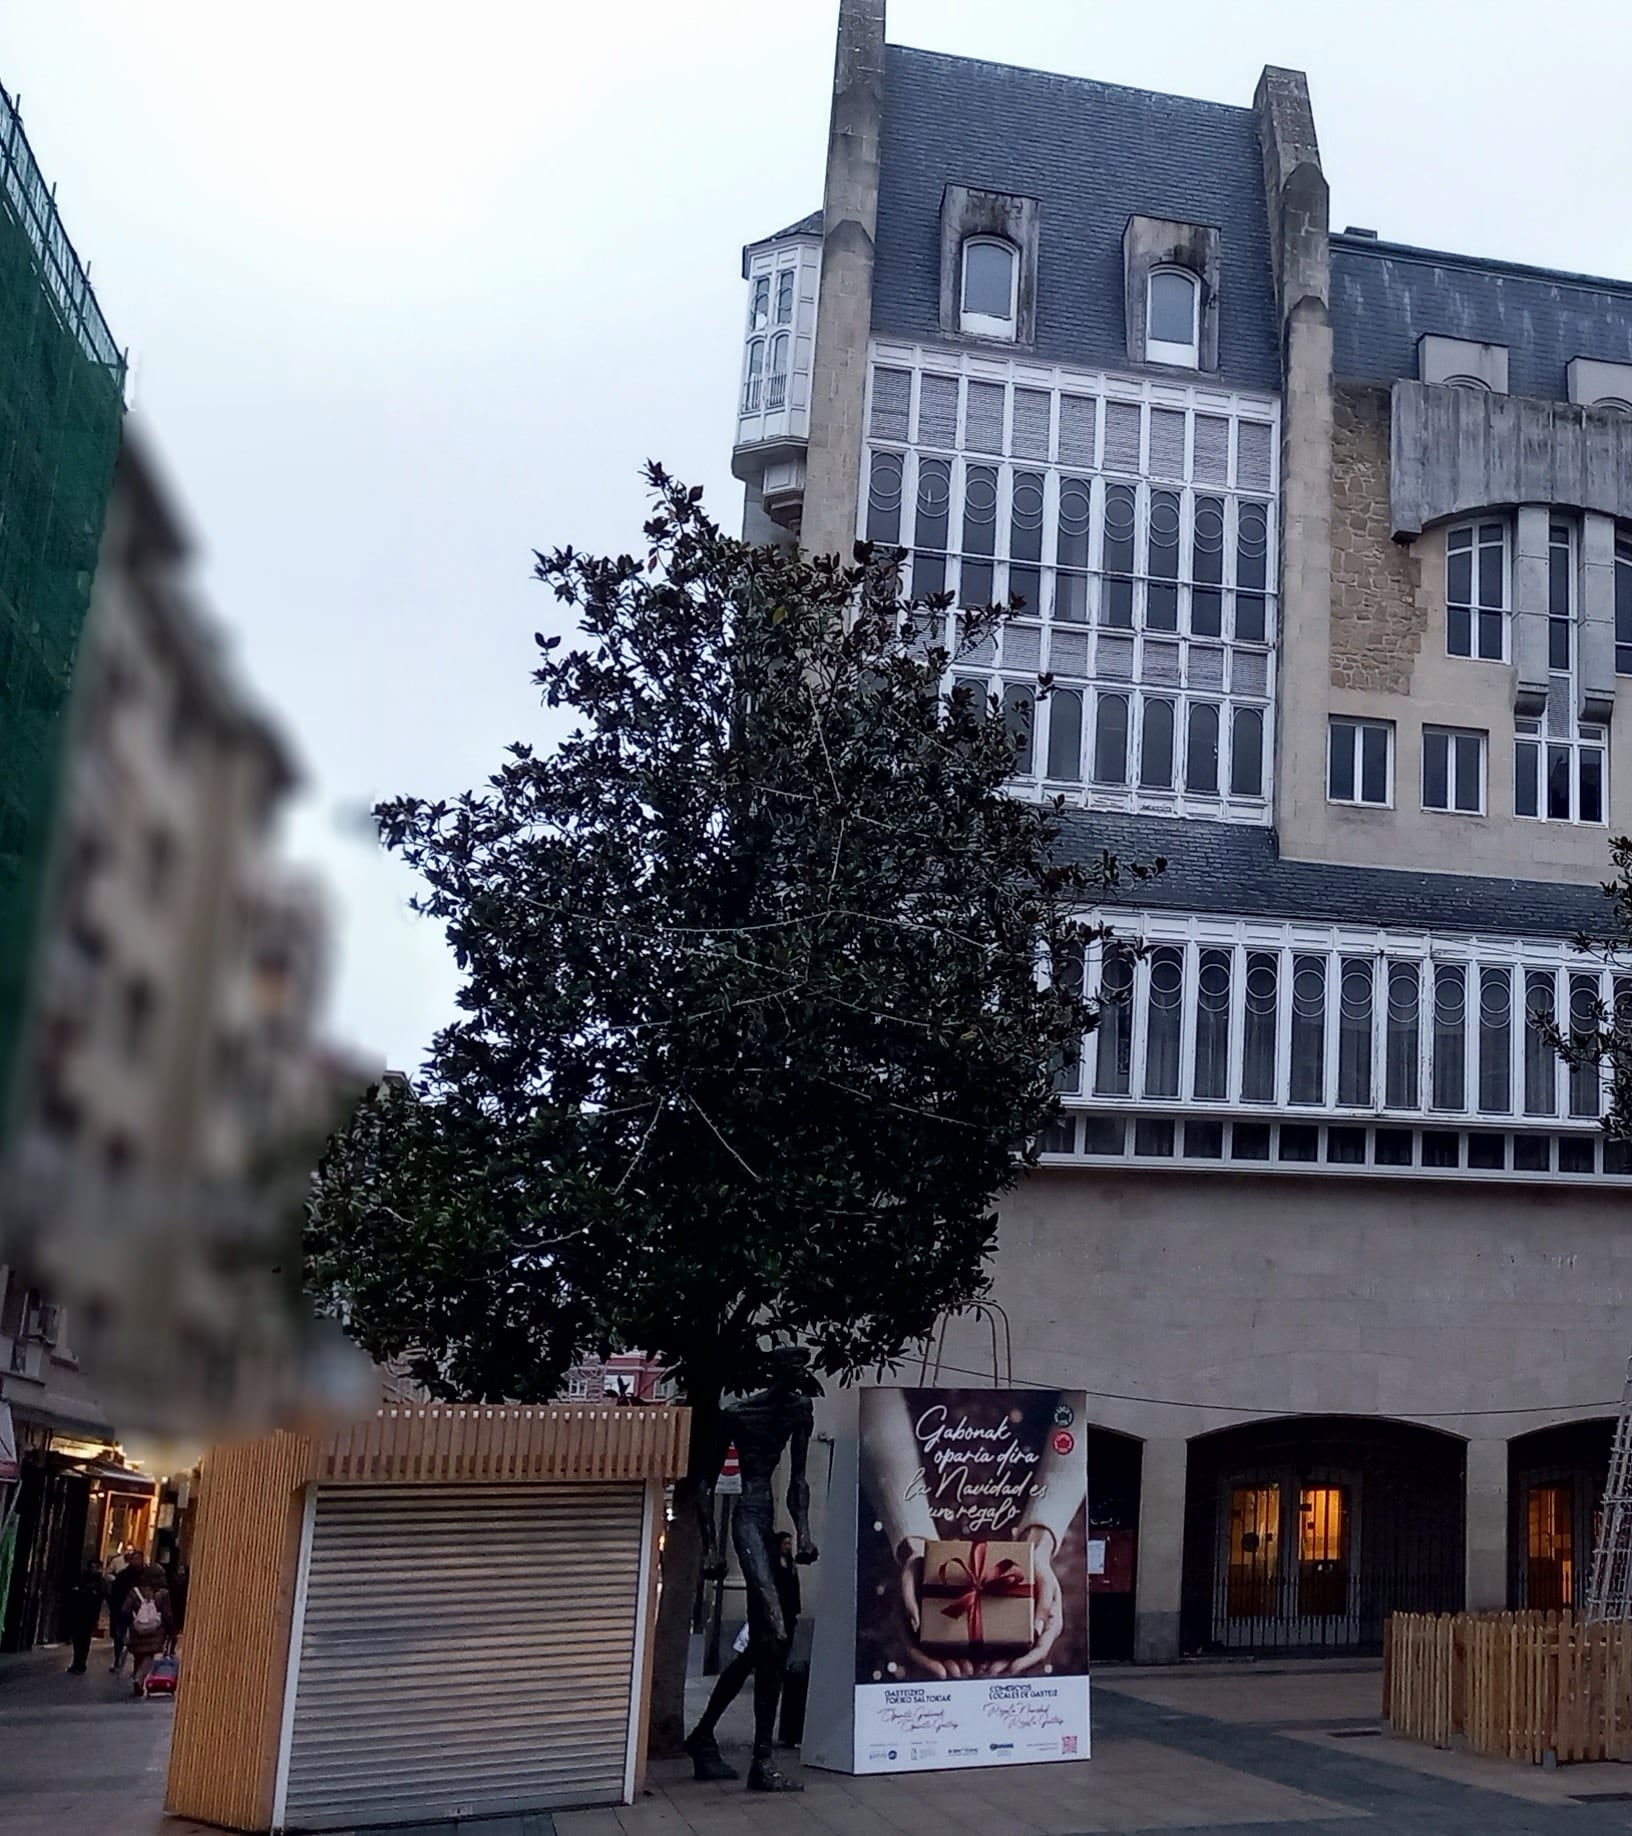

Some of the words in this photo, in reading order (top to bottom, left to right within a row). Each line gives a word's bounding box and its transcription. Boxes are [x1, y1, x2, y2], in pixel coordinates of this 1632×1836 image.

[916, 1405, 1011, 1453] Gabonak
[934, 1446, 994, 1474] oparia
[997, 1439, 1039, 1476] dira
[904, 1467, 931, 1500] la
[935, 1466, 1033, 1503] Navidad
[1029, 1484, 1048, 1499] es
[955, 1497, 1020, 1531] regalo
